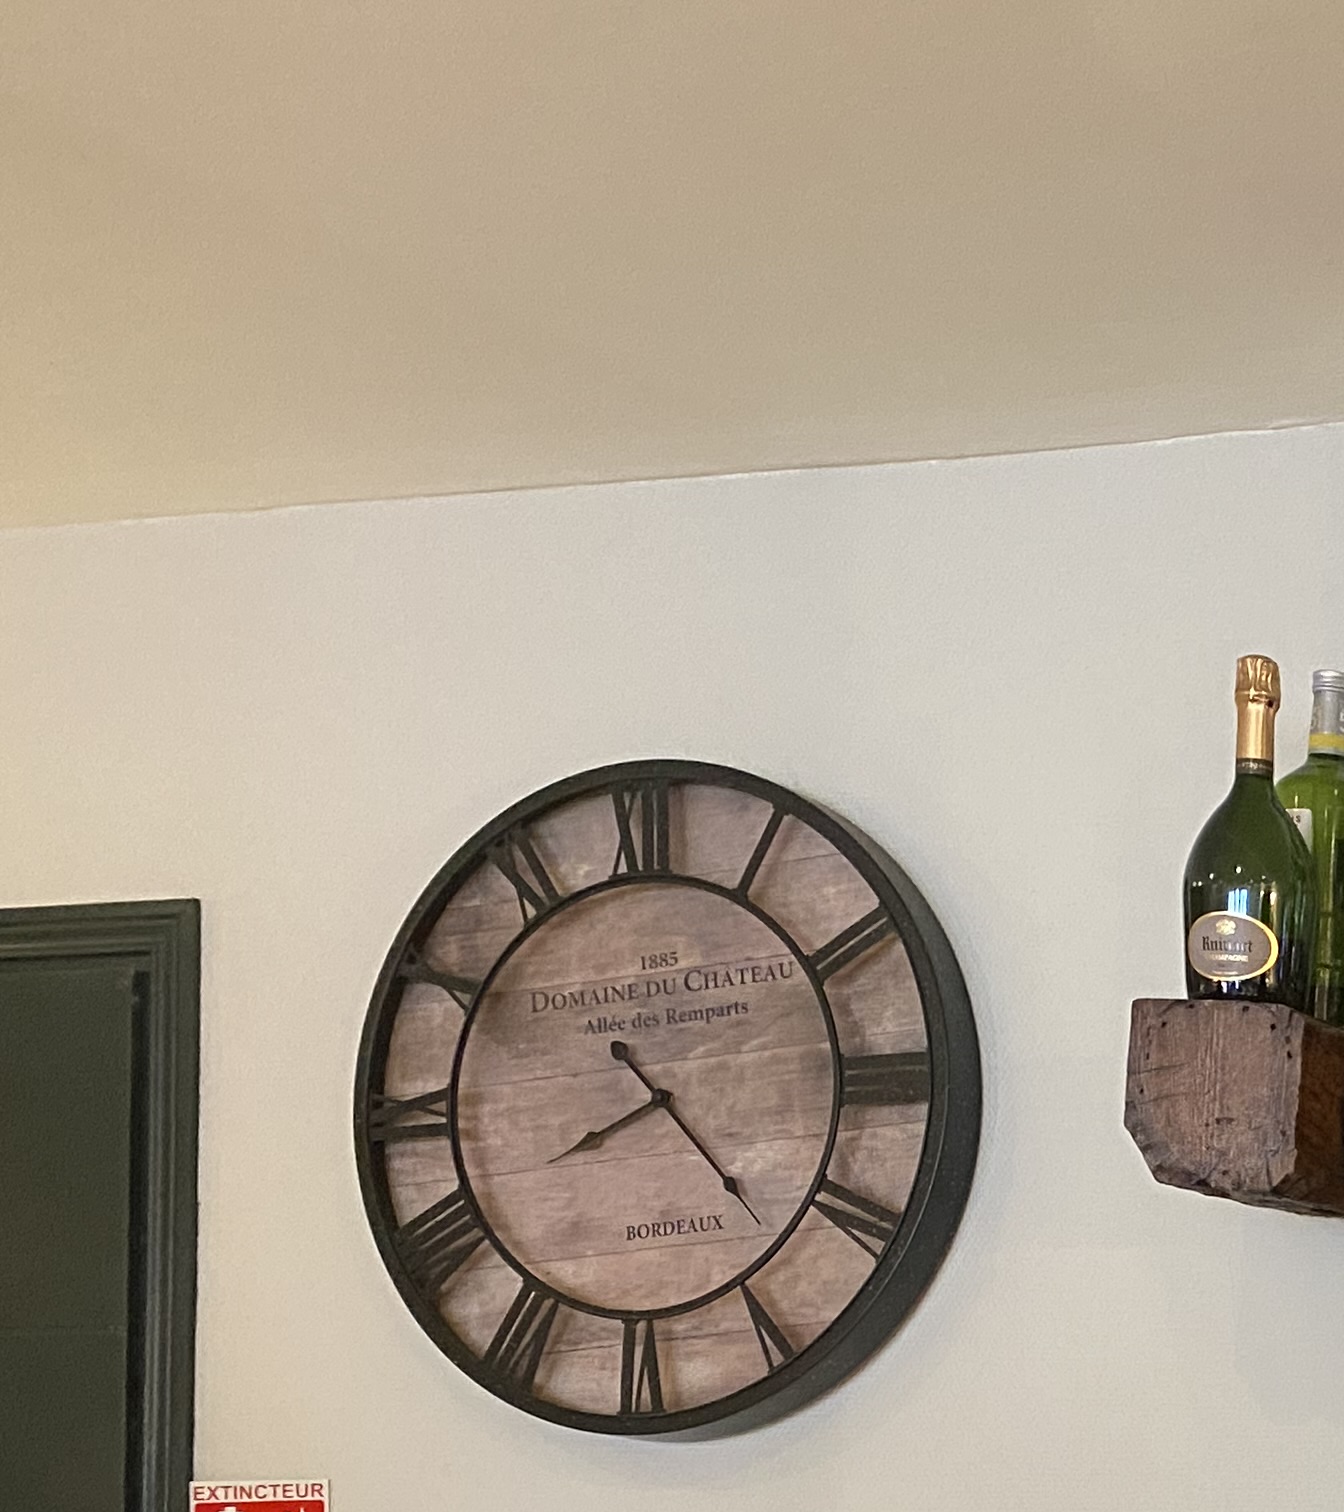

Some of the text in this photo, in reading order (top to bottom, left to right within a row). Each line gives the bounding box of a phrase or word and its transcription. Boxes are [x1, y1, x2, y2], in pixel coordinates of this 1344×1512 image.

[640, 951, 679, 971] 1885
[645, 976, 677, 999] DU
[583, 999, 749, 1036] Allée des Remparts
[625, 1213, 725, 1242] BORDEAUX
[193, 1483, 325, 1501] EXTINCTEUR
